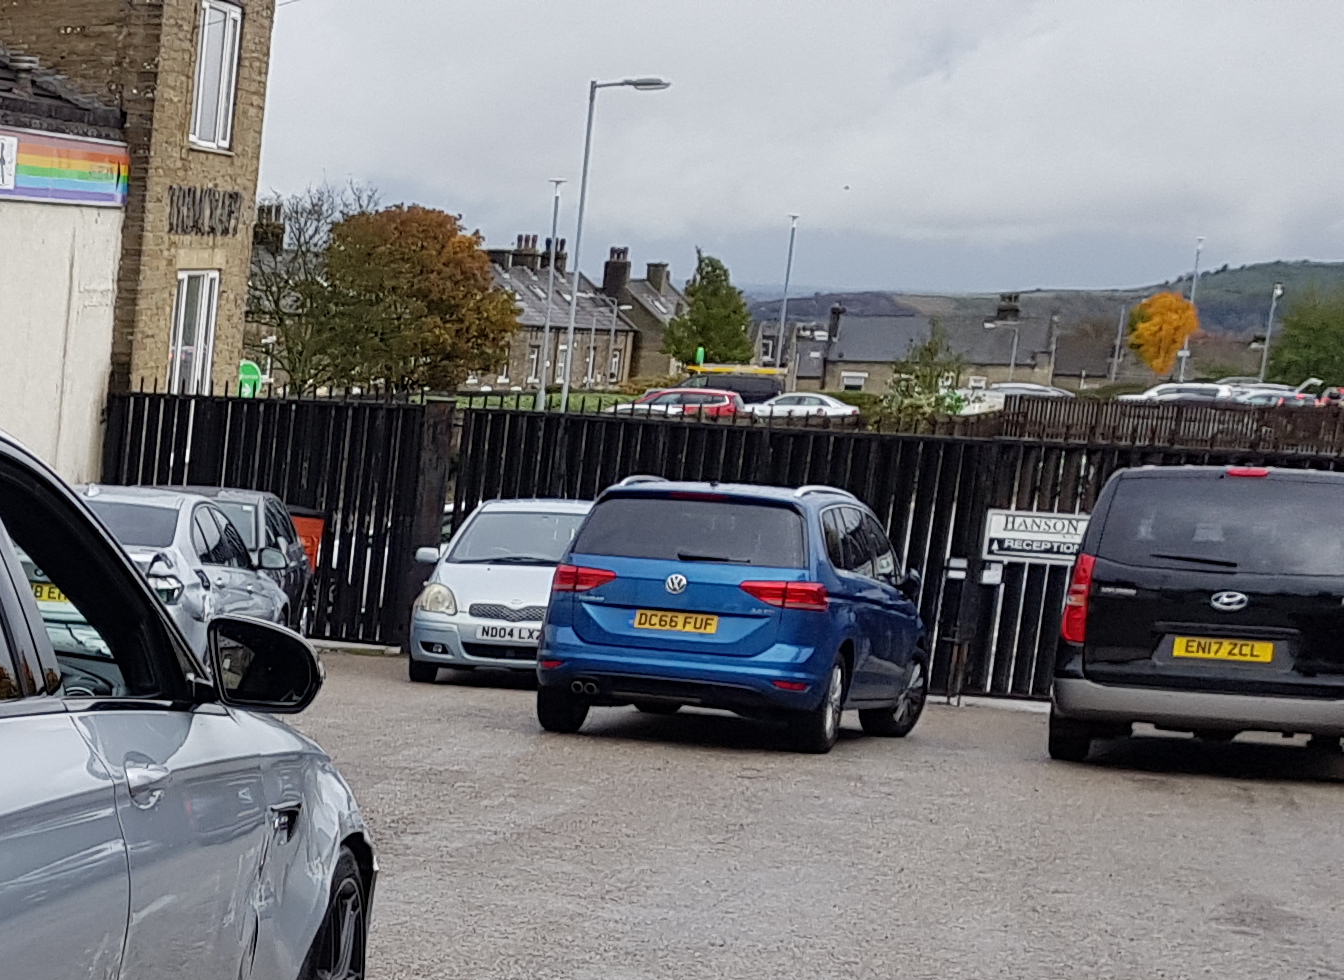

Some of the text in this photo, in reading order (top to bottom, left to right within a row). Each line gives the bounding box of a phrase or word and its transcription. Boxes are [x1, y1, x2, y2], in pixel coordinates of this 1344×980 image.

[1003, 515, 1080, 535] HANSON
[637, 612, 715, 631] DC66 FUF
[481, 625, 514, 638] ND04
[1184, 639, 1261, 658] EN17 ZCL
